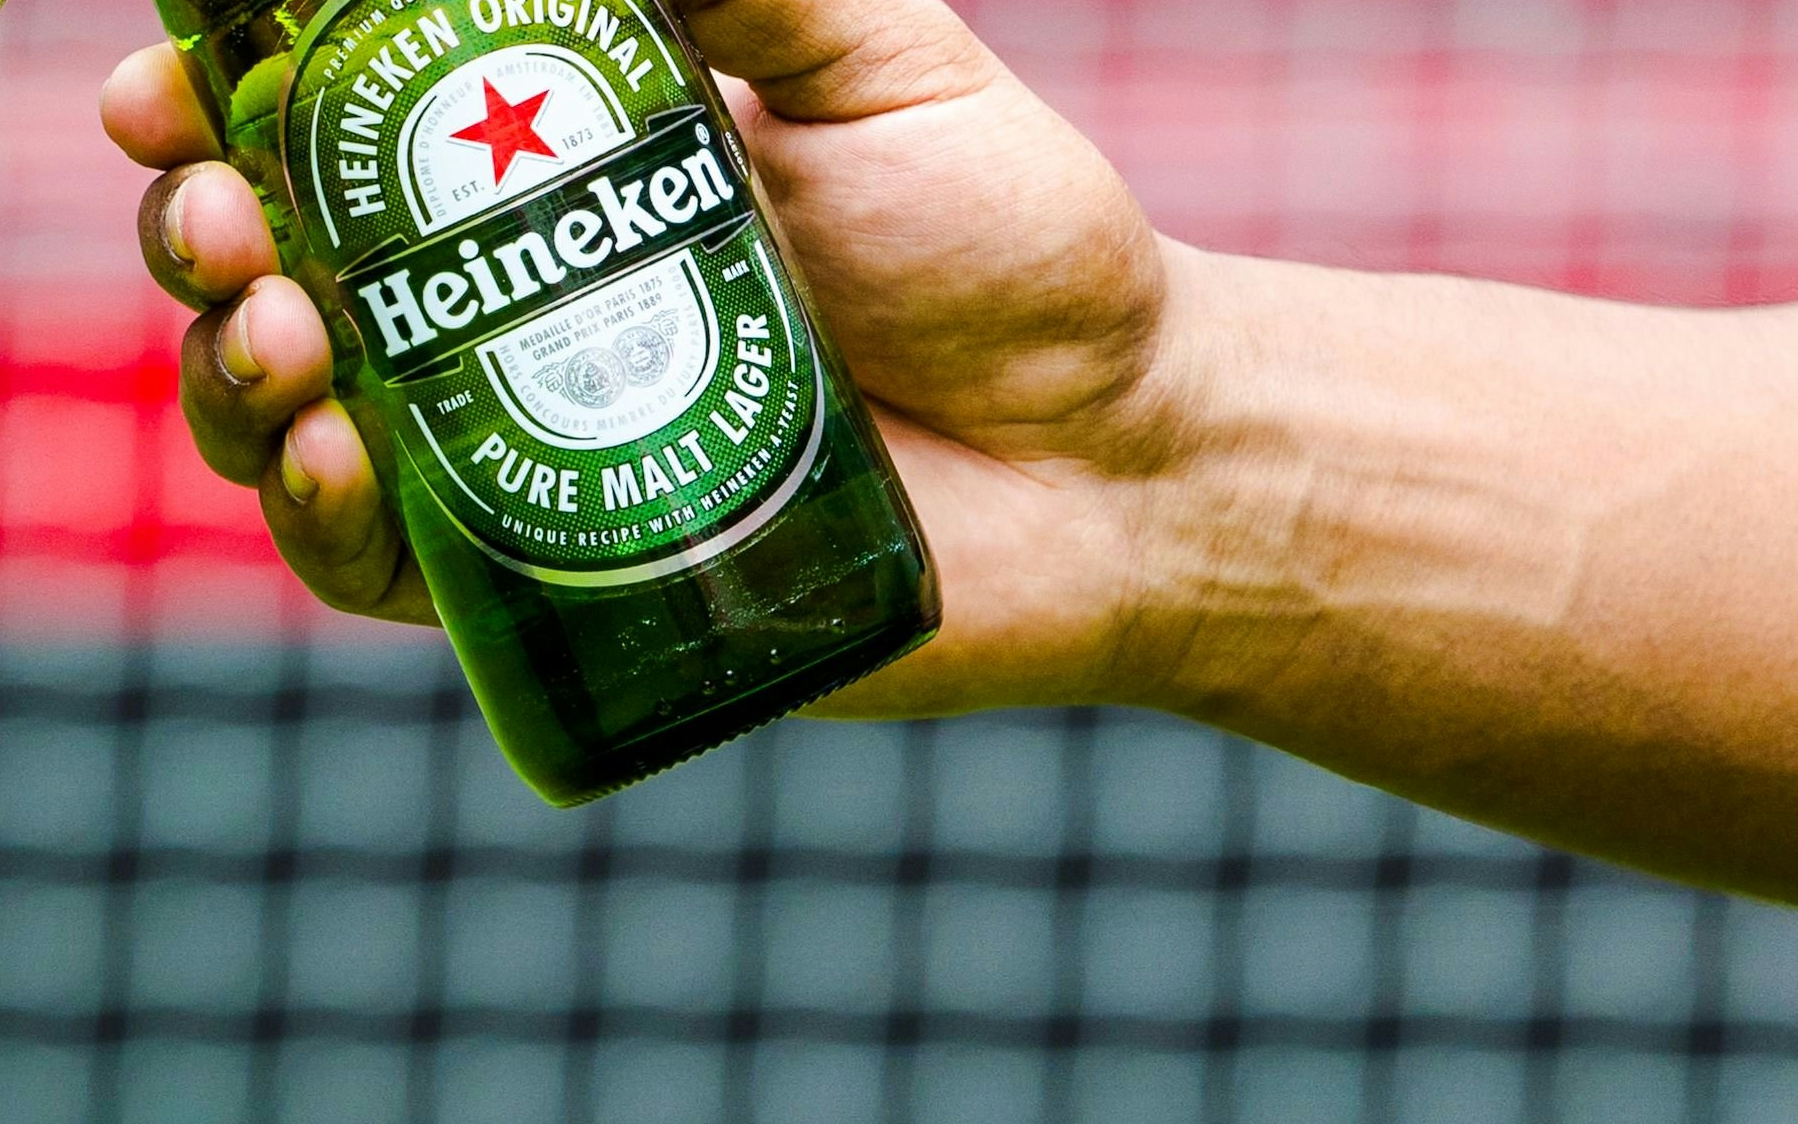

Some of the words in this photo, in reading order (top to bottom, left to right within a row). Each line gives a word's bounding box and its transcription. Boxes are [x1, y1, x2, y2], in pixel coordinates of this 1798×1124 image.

[323, 9, 386, 80] PREMIUM
[338, 7, 461, 218] HEINEKEN
[419, 158, 447, 217] DIPLOME
[496, 61, 575, 82] AMSTERDAM
[452, 180, 485, 202] EST.
[562, 128, 593, 150] 1873
[519, 318, 572, 351] MEDAILLE
[574, 305, 602, 325] D'OR
[605, 289, 636, 311] PARIS
[638, 276, 663, 293] 1875
[532, 338, 572, 361] GRAND
[574, 323, 601, 342] PRIX
[603, 306, 635, 328] PARIS
[638, 293, 662, 311] 1889
[436, 389, 474, 415] TRADE
[470, 432, 580, 513] PURE
[601, 429, 713, 511] MALT
[709, 314, 772, 446] LAGER
[520, 385, 588, 431] CONCOURS
[658, 387, 677, 406] DU
[502, 513, 567, 545] UNIQUE
[578, 524, 642, 546] RECIPE
[648, 505, 696, 534] WITH
[700, 447, 771, 511] HEINEKEN
[770, 380, 799, 448] A-YEAST
